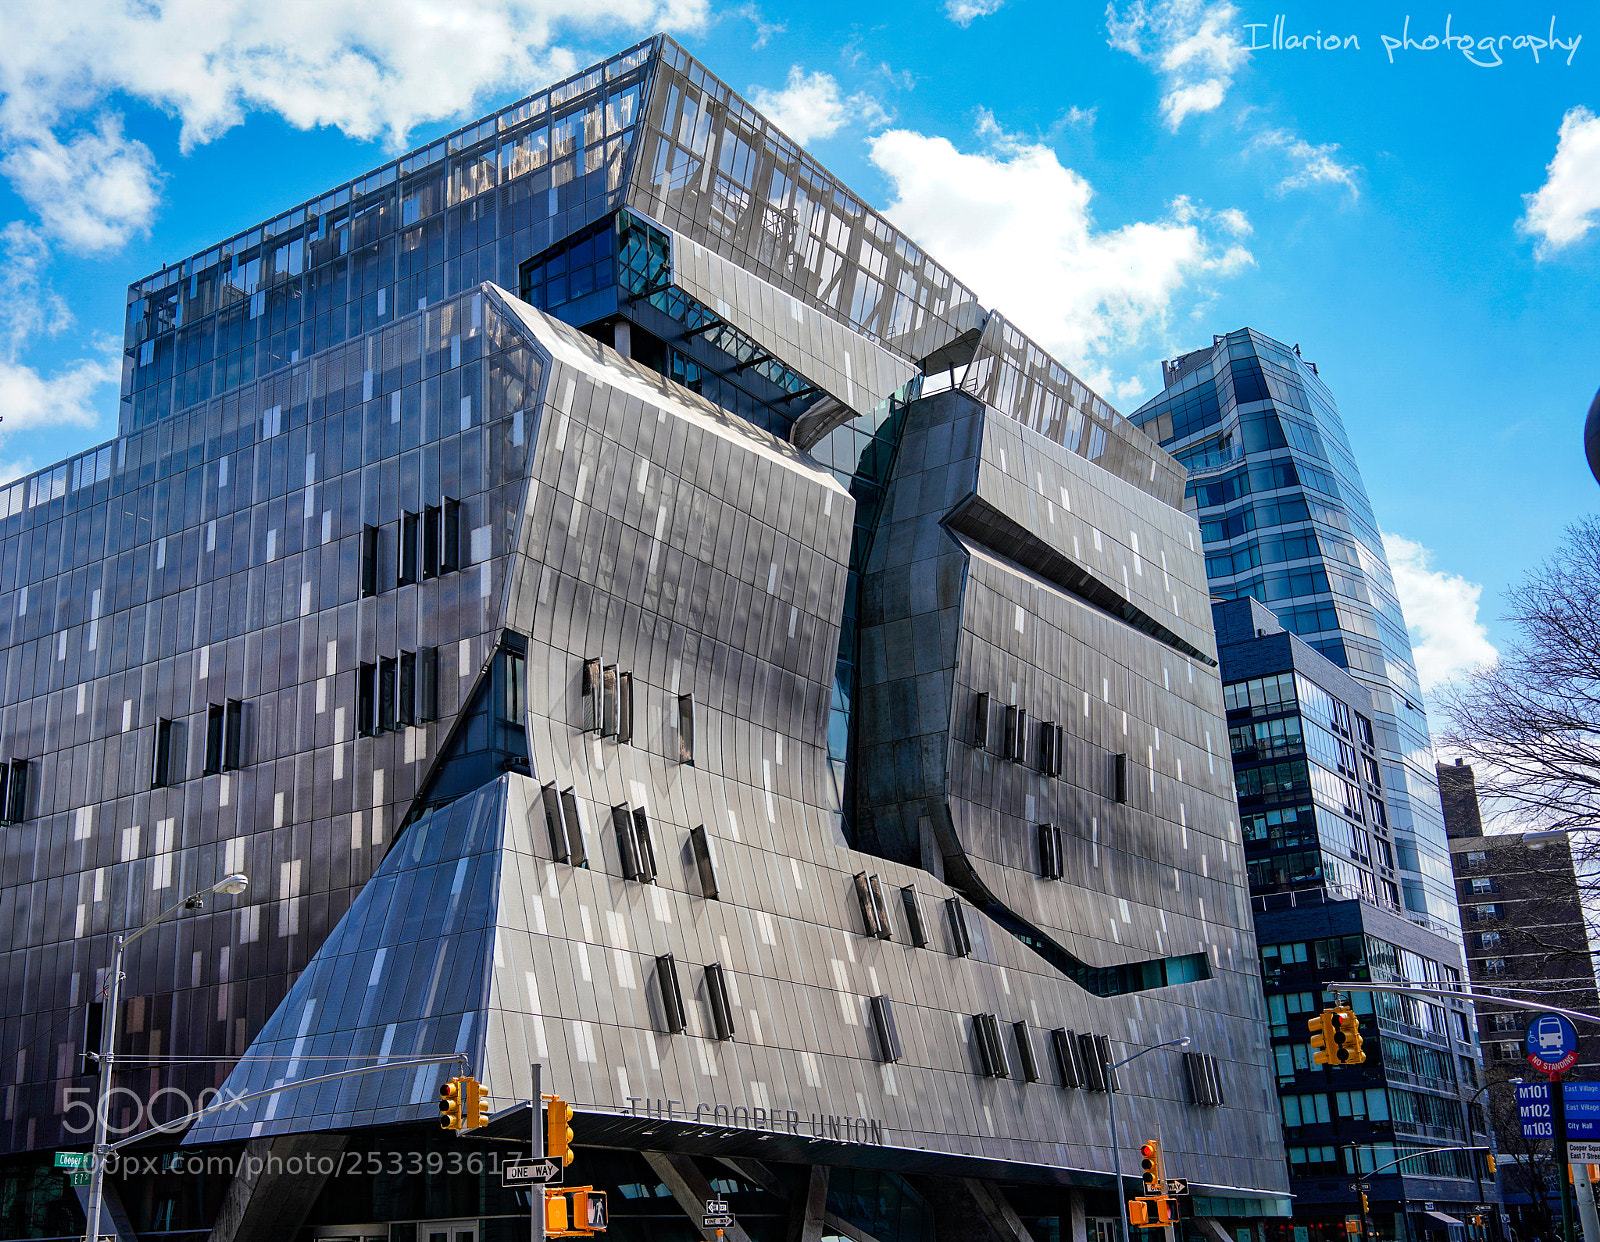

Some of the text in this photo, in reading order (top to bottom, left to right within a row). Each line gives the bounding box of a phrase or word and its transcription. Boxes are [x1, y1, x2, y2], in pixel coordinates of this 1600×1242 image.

[1531, 1054, 1575, 1071] NO STANDING
[1519, 1085, 1548, 1099] M101
[1579, 1085, 1599, 1093] Village
[1520, 1104, 1551, 1118] M102
[1580, 1104, 1600, 1112] Village
[626, 1097, 883, 1146] THE COOPER UNION
[1567, 1122, 1579, 1131] City
[1523, 1122, 1553, 1136] M103
[1569, 1144, 1587, 1152] Cooper
[60, 1154, 81, 1167] Cooper
[511, 1165, 554, 1178] ONE WAY
[74, 1173, 78, 1185] E
[80, 1173, 84, 1184] 7
